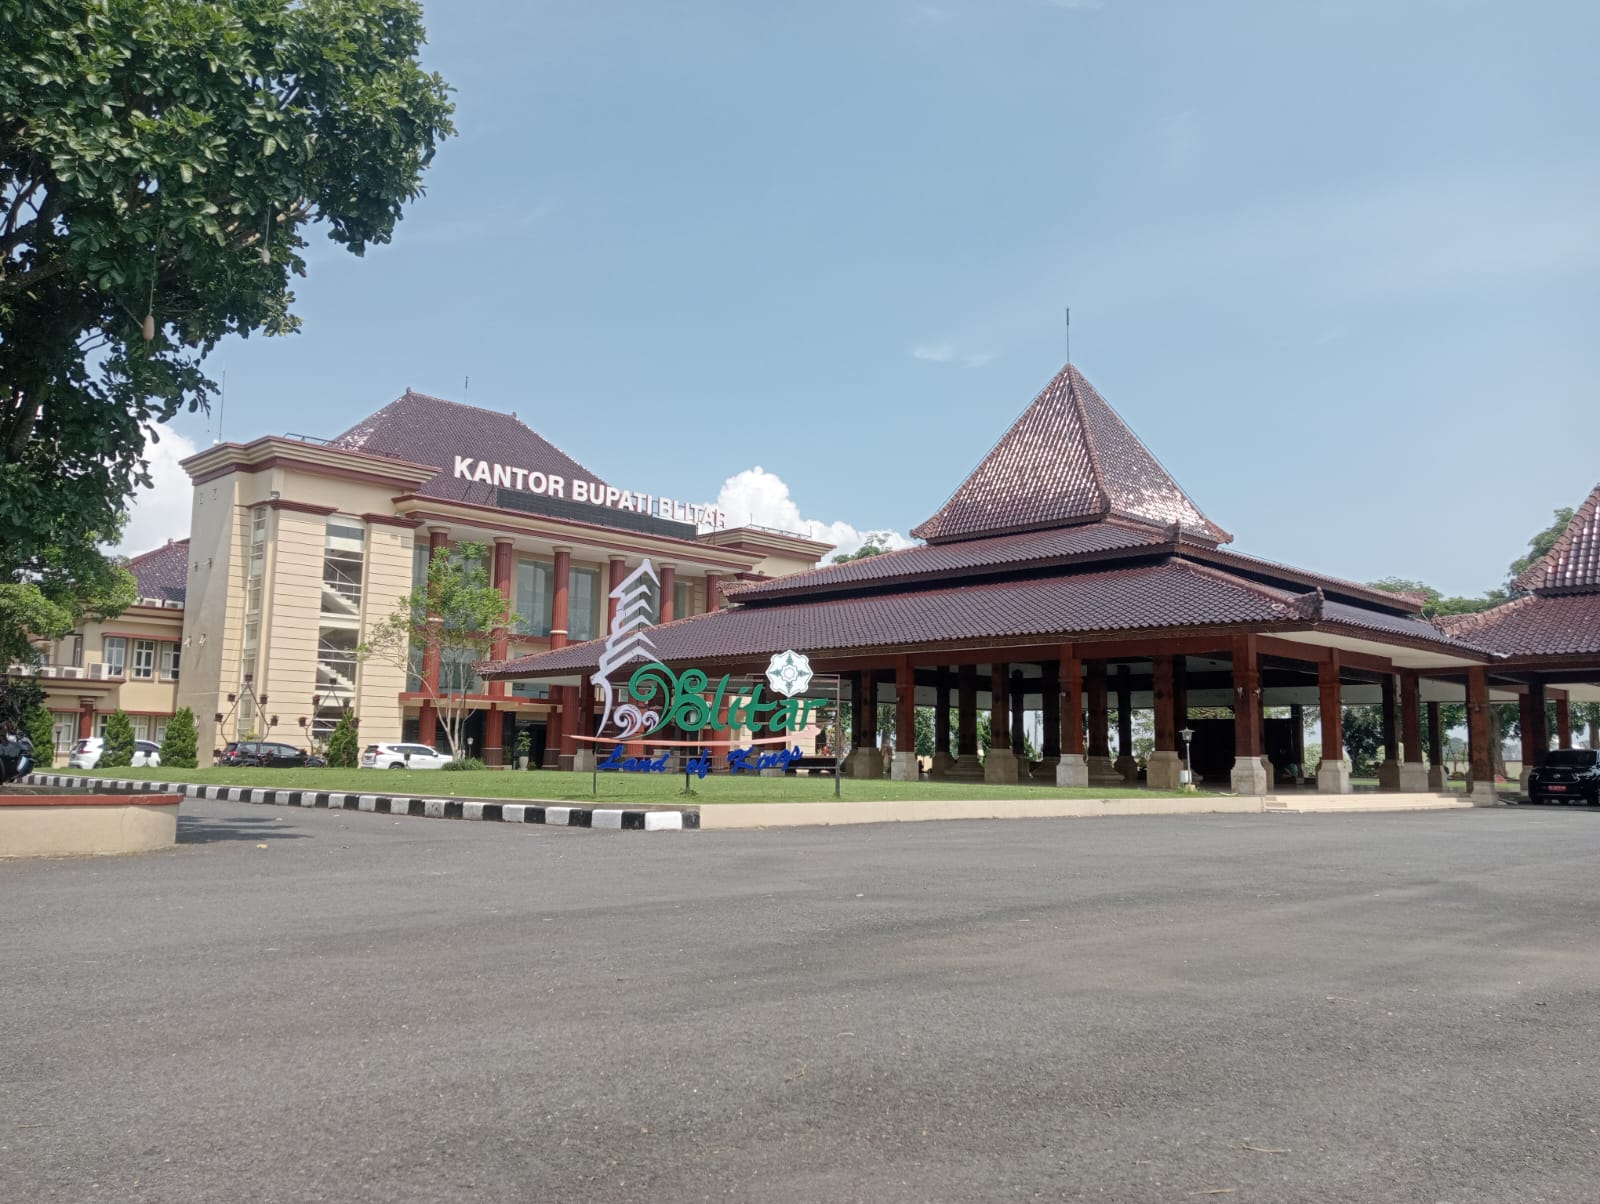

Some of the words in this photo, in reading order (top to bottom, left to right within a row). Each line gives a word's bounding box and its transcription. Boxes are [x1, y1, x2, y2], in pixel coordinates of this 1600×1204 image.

[453, 455, 565, 498] KANTOR
[571, 479, 653, 516] BUPATI
[658, 496, 726, 529] BLITAR
[628, 662, 828, 739] Blitar
[598, 744, 670, 772] Land
[686, 748, 710, 779] of
[727, 745, 803, 774] Kings
